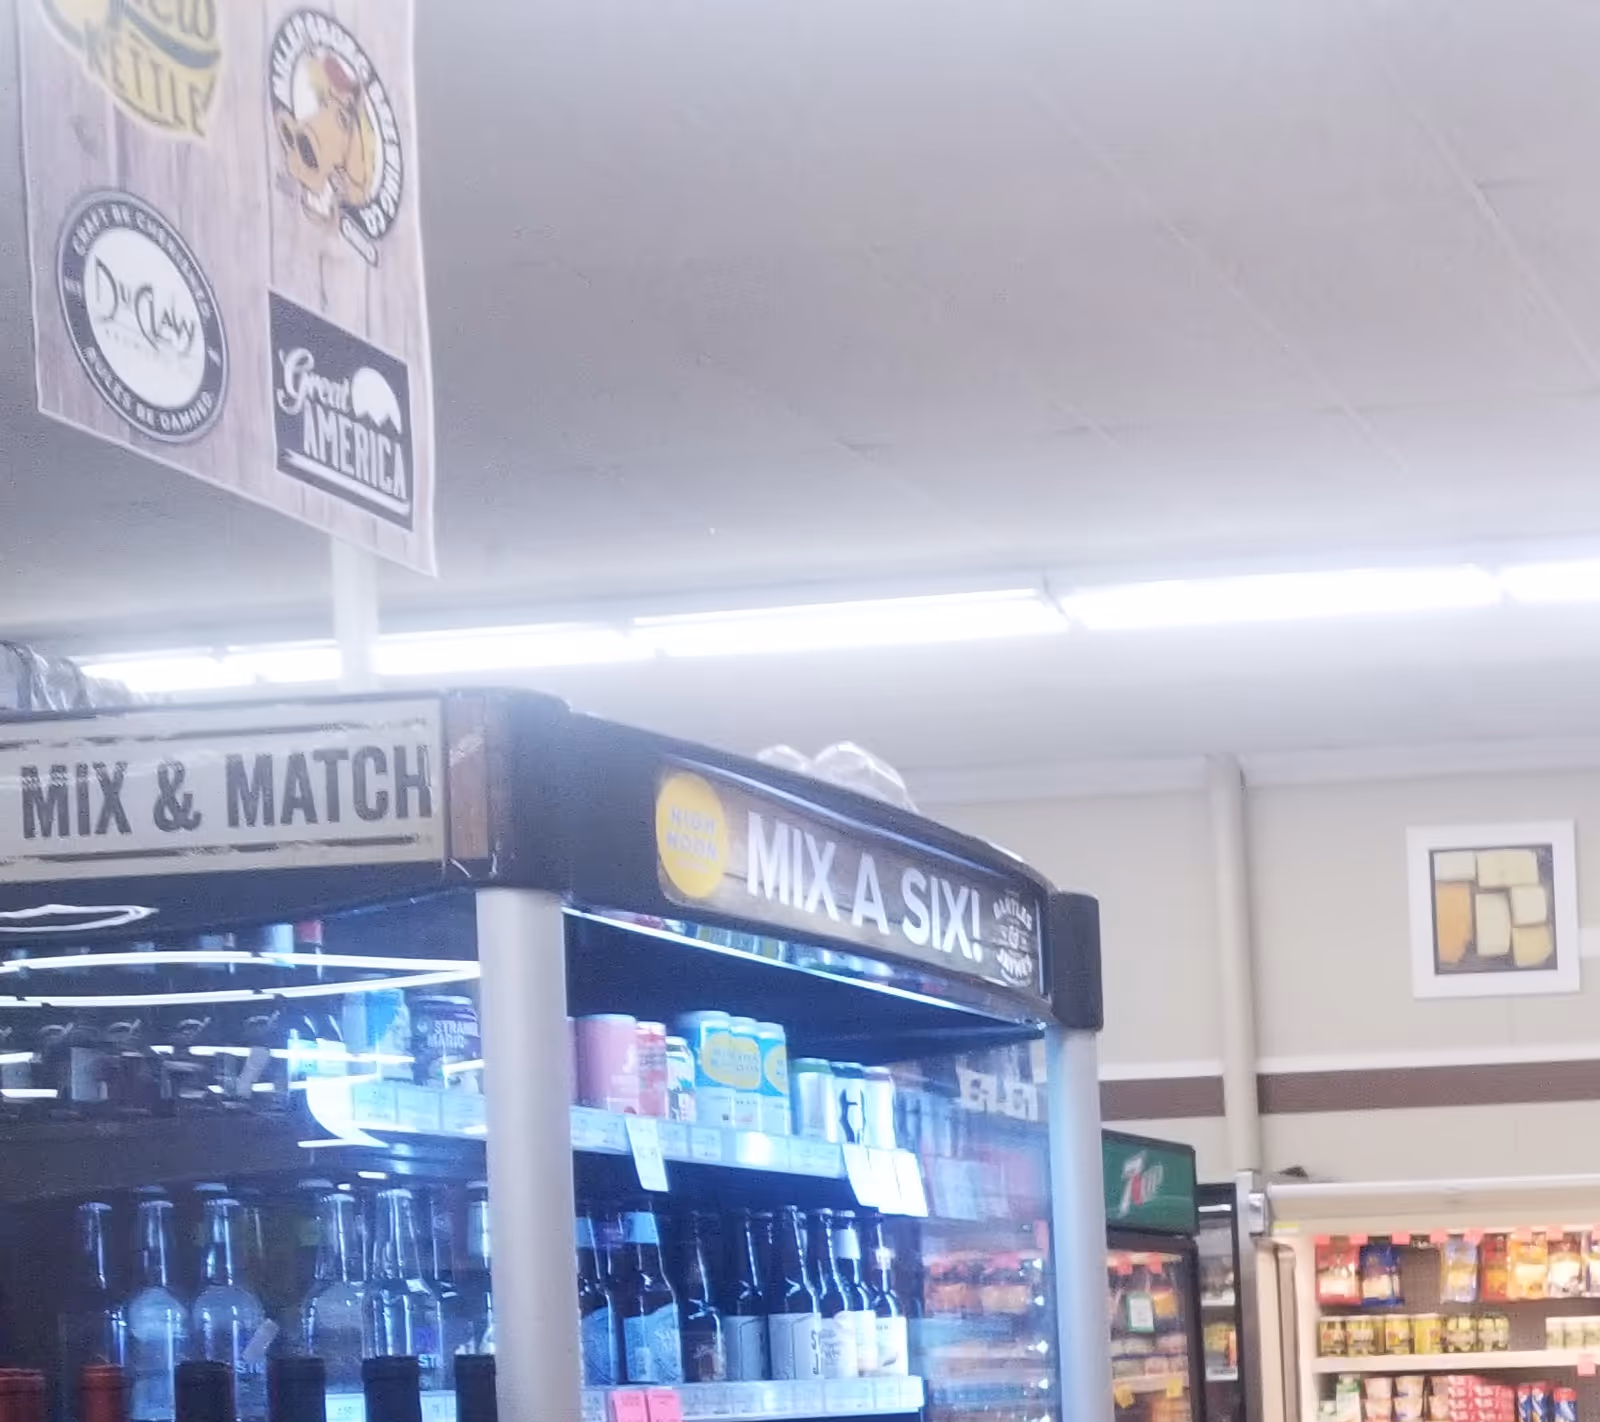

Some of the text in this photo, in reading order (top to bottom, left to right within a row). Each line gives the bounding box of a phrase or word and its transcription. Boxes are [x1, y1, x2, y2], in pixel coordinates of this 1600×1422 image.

[277, 347, 350, 416] Great
[303, 398, 408, 500] AMERICA
[20, 744, 433, 839] MIX & MATCH
[746, 810, 984, 963] MIX A SIX!
